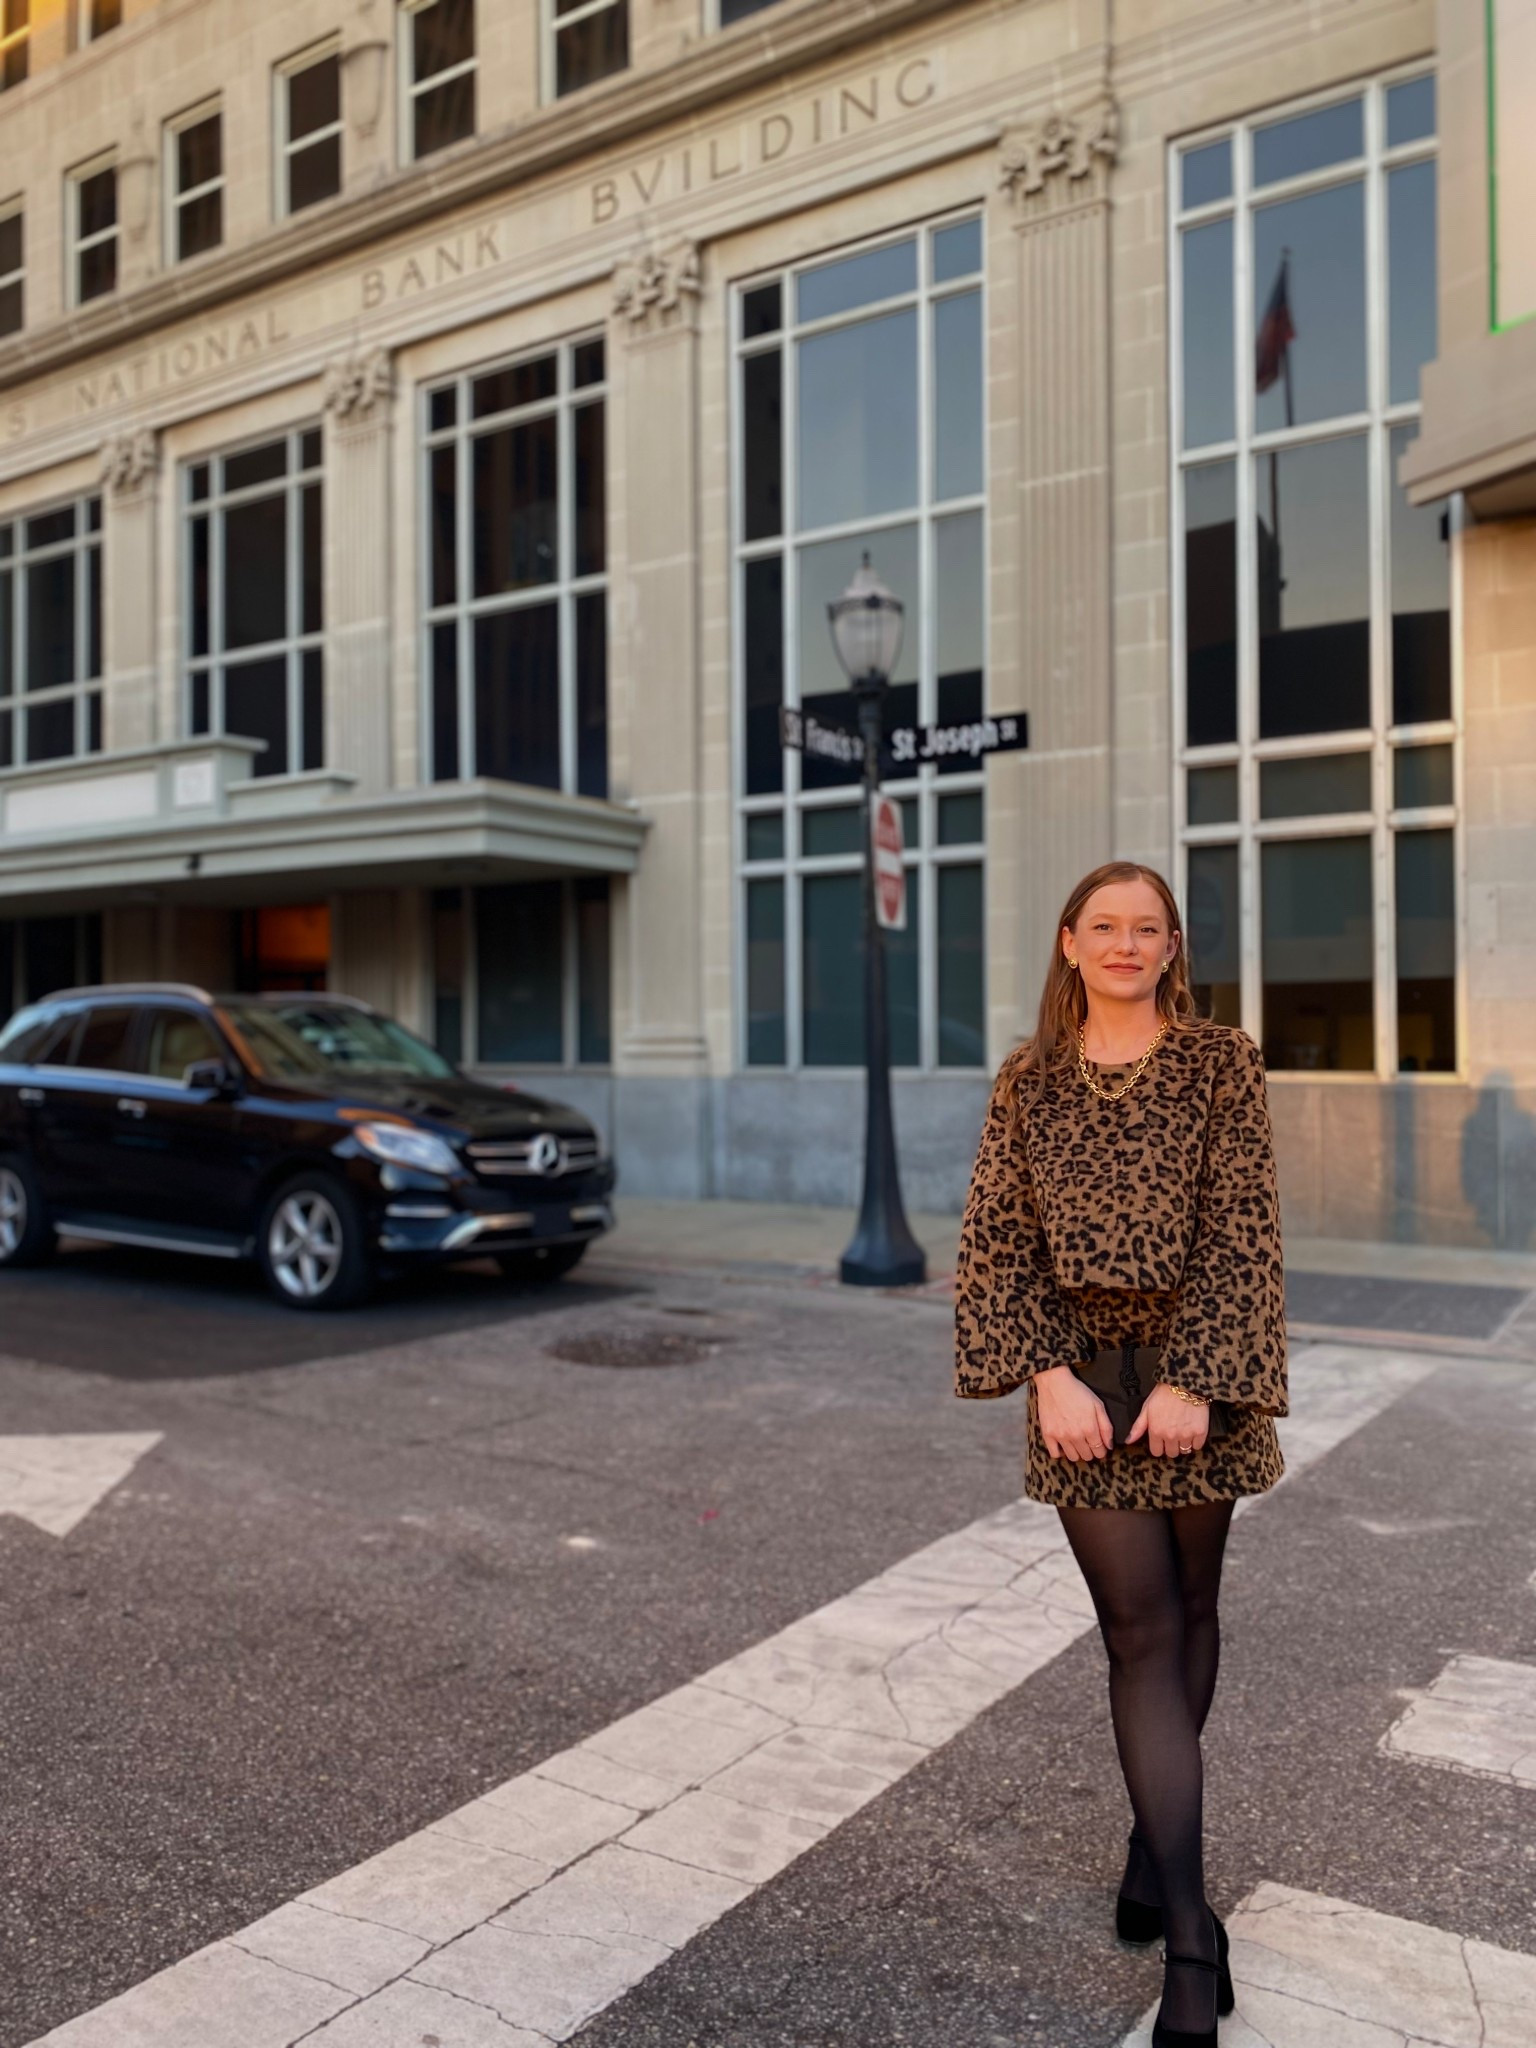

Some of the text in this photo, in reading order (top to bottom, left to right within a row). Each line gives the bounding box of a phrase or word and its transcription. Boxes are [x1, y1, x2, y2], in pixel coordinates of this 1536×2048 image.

[75, 309, 291, 415] NATIONAL
[361, 223, 502, 310] BANK
[590, 58, 936, 225] BVILDING
[891, 728, 917, 761] St
[919, 719, 999, 758] Joseph
